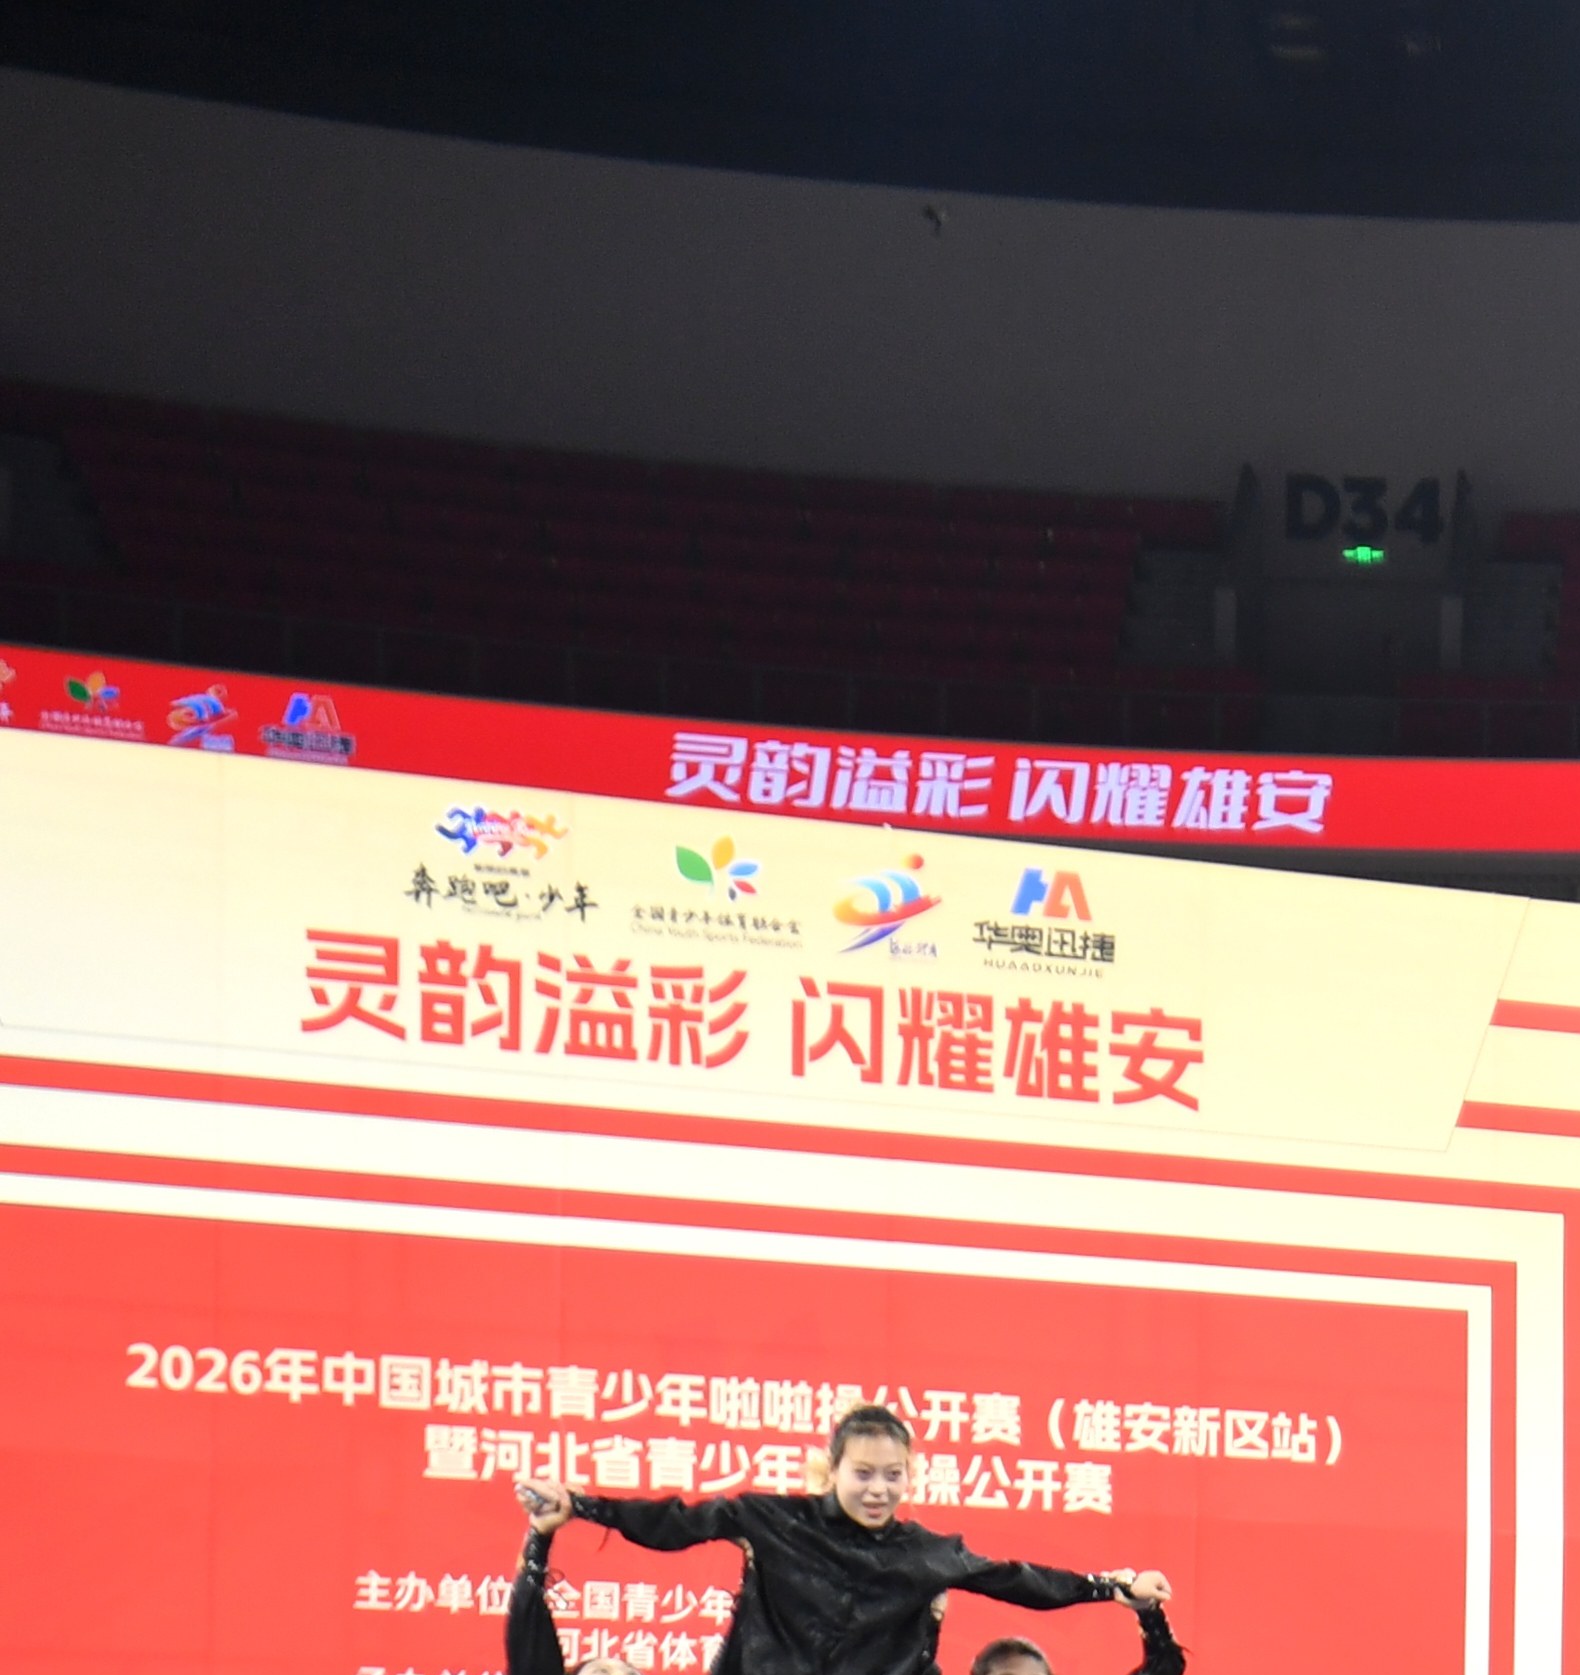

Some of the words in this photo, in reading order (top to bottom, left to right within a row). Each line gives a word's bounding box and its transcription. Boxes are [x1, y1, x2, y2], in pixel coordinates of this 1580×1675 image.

[1285, 471, 1445, 543] D34
[665, 731, 996, 818] 灵韵溢彩
[1007, 756, 1333, 834] 闪耀雄安
[973, 920, 1116, 963] 华奥迅捷
[299, 928, 750, 1071] 灵韵溢彩
[790, 974, 1204, 1113] 闪耀雄安
[353, 1569, 513, 1617] 主办单位
